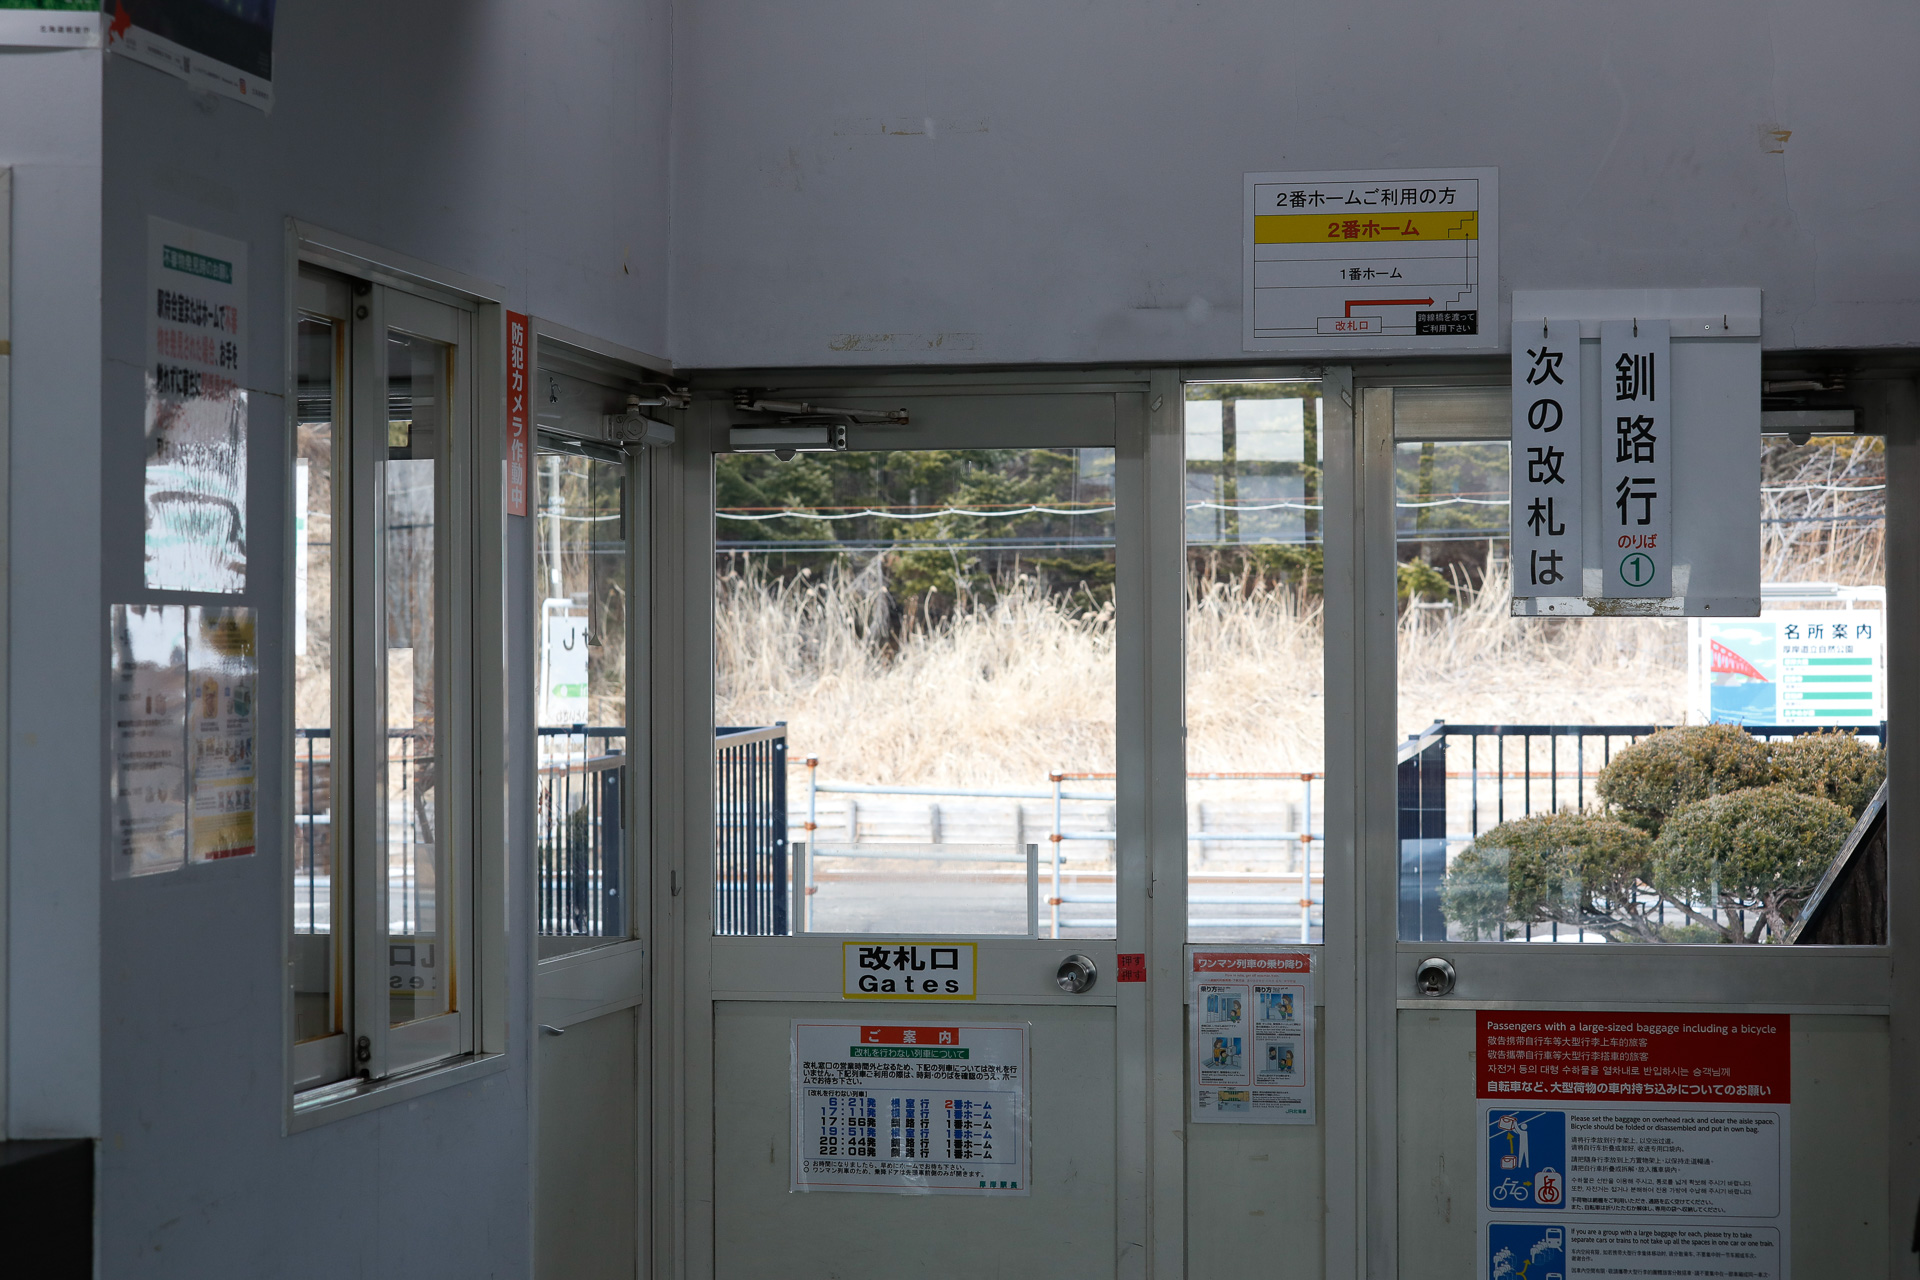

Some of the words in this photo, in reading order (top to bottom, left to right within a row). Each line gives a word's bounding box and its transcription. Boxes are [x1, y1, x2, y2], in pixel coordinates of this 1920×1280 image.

[1276, 187, 1457, 208] 2番ホームご利用の方
[1327, 219, 1420, 239] 2番ホーム
[1340, 267, 1403, 281] 1番ホーム
[1417, 313, 1475, 323] 跨線橋を渡って
[1335, 321, 1369, 331] 改札口
[1422, 324, 1471, 333] ご利用下さい
[511, 322, 523, 509] 防犯カメラ作動中
[1615, 352, 1657, 526] 釧路行
[1526, 346, 1566, 586] 次の改札は
[1617, 533, 1658, 549] のりば
[1784, 623, 1871, 640] 名所案内
[1783, 645, 1853, 653] 厚岸道立自然公園
[858, 946, 959, 971] 改札口
[1122, 956, 1142, 966] 押す
[1198, 958, 1303, 970] ワンマン列車の乗り降り
[1121, 970, 1143, 981] 押す
[858, 974, 959, 993] Gates
[1487, 1021, 1541, 1032] Passengers
[1544, 1021, 1566, 1031] with
[1579, 1022, 1633, 1034] large-sized
[1636, 1022, 1679, 1034] baggage
[1682, 1023, 1728, 1035] including
[1741, 1024, 1776, 1035] bicycle
[868, 1029, 952, 1044] ご案内
[1487, 1036, 1648, 1048] 敬告携带自行车等大型行李上车的旅客
[854, 1048, 965, 1059] 改札を行わない列車について
[1487, 1050, 1649, 1062] 敬告攜帶自行車等大型行李搭車的旅客
[1487, 1063, 1515, 1073] 자전거
[1518, 1064, 1537, 1074] 등의
[1540, 1064, 1558, 1074] 대형
[1561, 1065, 1599, 1075] 수하물을
[1602, 1065, 1640, 1075] 열차내로
[1643, 1066, 1689, 1076] 반입하시는
[1692, 1067, 1730, 1076] 승객님께
[803, 1077, 863, 1085] ムでお待ち下さい。
[1487, 1081, 1771, 1096] 自転車など、大型荷物の車内持ち込みについてのお願い
[945, 1100, 992, 1110] 2番ホーム
[946, 1110, 992, 1119] 1番ホーム
[1614, 1116, 1640, 1124] baggage
[946, 1120, 992, 1129] 1番ホーム
[1570, 1124, 1592, 1132] Bicycle
[1710, 1126, 1722, 1134] put
[1745, 1126, 1759, 1134] bag.
[946, 1130, 992, 1139] 1番ホーム
[946, 1139, 992, 1149] 1番ホーム
[946, 1149, 992, 1159] 1番ホーム
[1638, 1230, 1652, 1238] large
[1653, 1230, 1677, 1238] baggage
[1687, 1230, 1702, 1239] each,
[1703, 1231, 1722, 1239] please
[1722, 1231, 1731, 1239] try
[1570, 1237, 1594, 1245] separate
